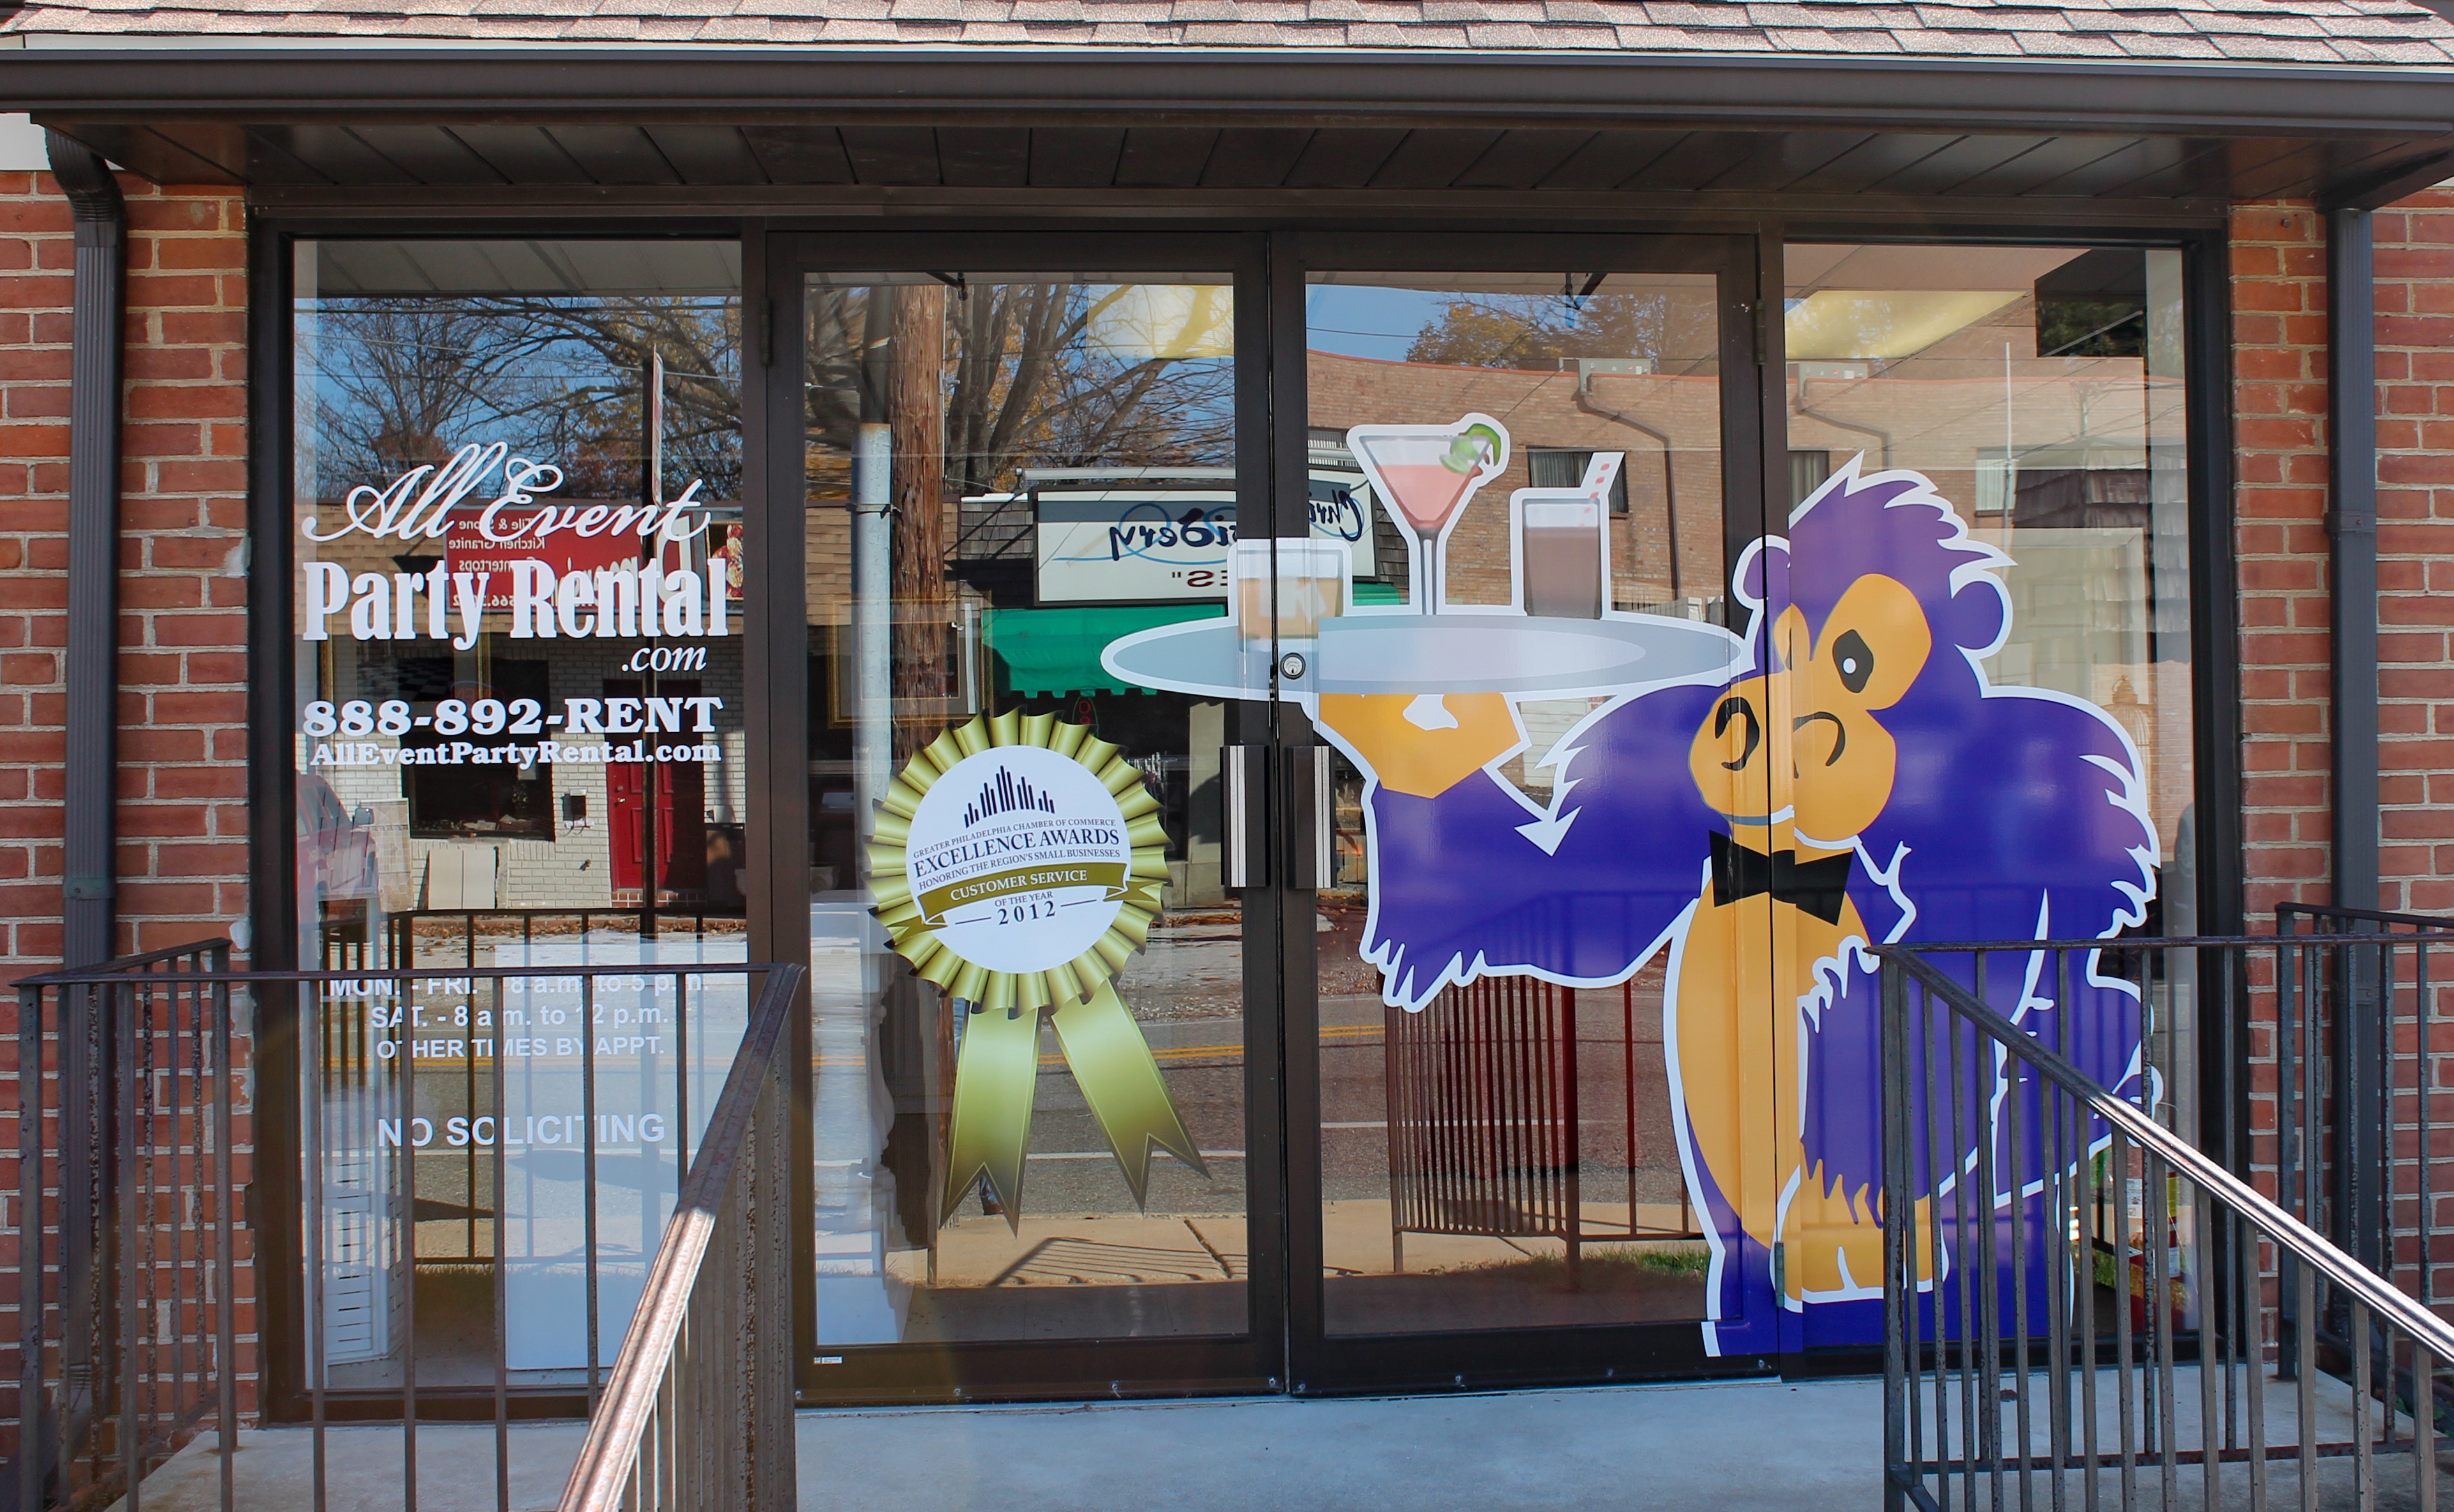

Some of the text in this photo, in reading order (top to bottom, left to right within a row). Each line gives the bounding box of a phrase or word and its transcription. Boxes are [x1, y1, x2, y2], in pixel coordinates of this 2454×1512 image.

[301, 442, 712, 543] All Event
[303, 559, 490, 651] Party
[509, 558, 728, 638] Rental
[621, 646, 707, 672] .com
[303, 696, 724, 737] 888-892-RENT
[310, 739, 721, 770] AllEventPartyRental.com
[913, 818, 1117, 859] GREATER PHILADELPHIA CHAMBER OF COMMERCE
[914, 828, 1120, 879] EXCELLENCE AWARDS
[918, 848, 1121, 891] HONORING THE REGION'S SMALL BUSINESSES
[950, 869, 1088, 901] CUSTOMER SERVICE
[994, 891, 1053, 908] OF THE YEAR
[997, 900, 1056, 925] 2012
[329, 978, 401, 996] MON.
[427, 977, 478, 995] FRI.
[511, 976, 525, 994] 8
[534, 977, 583, 993] a.m
[596, 975, 622, 992] to
[631, 975, 646, 993] 5
[371, 1005, 428, 1028] SAT.
[454, 1005, 469, 1027] 8
[477, 1009, 531, 1027] am.
[539, 1004, 566, 1026] to
[614, 1006, 669, 1029] p.m.
[594, 1035, 665, 1055] APPT.
[377, 1117, 433, 1148] NO
